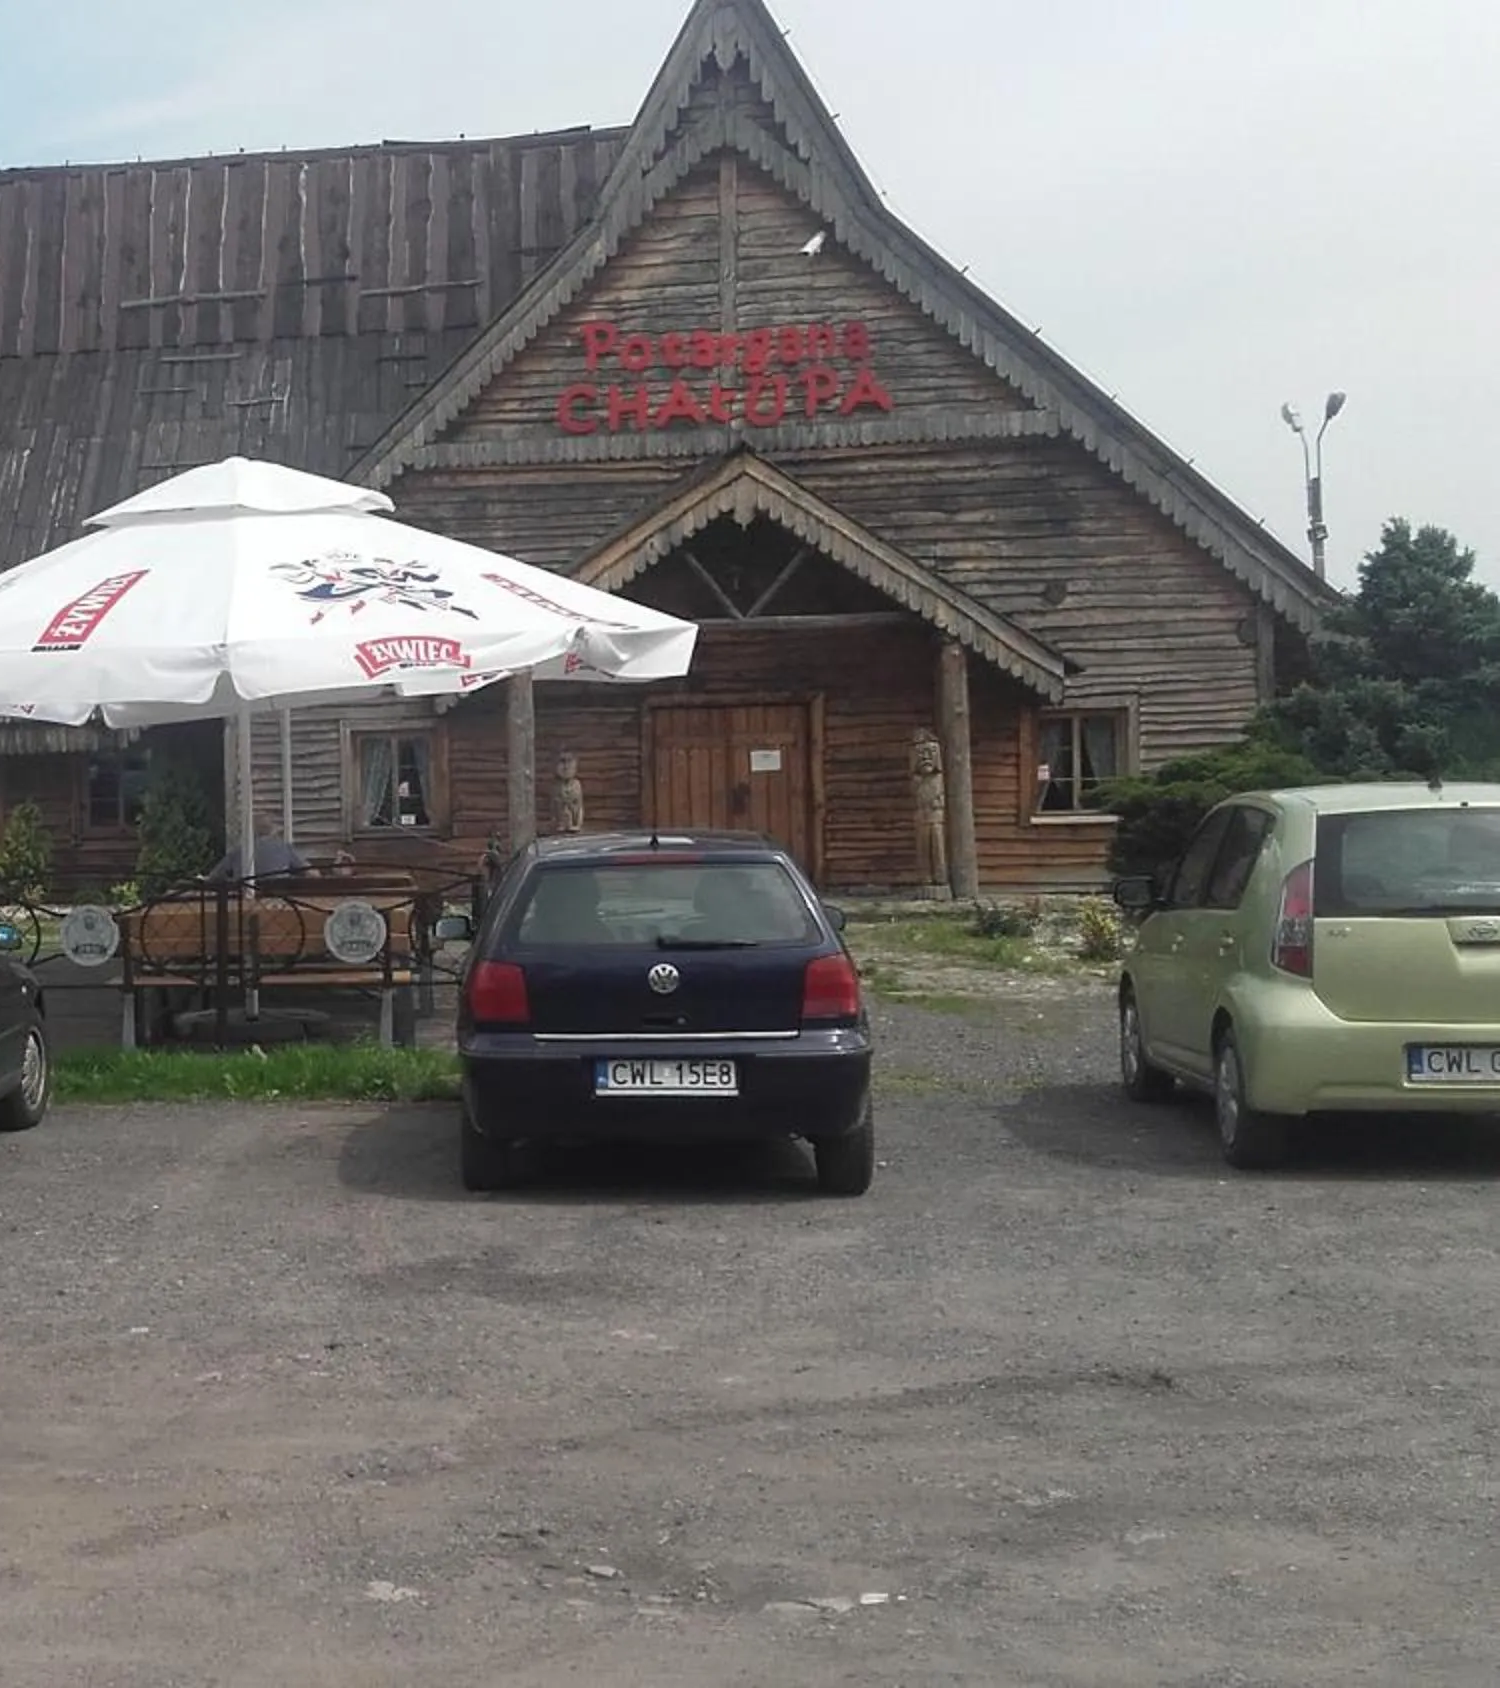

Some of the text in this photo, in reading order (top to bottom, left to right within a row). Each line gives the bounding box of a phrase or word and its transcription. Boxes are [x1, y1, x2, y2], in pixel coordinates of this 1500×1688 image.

[1427, 1050, 1483, 1073] CWL
[611, 1062, 734, 1086] CWL 15E8
